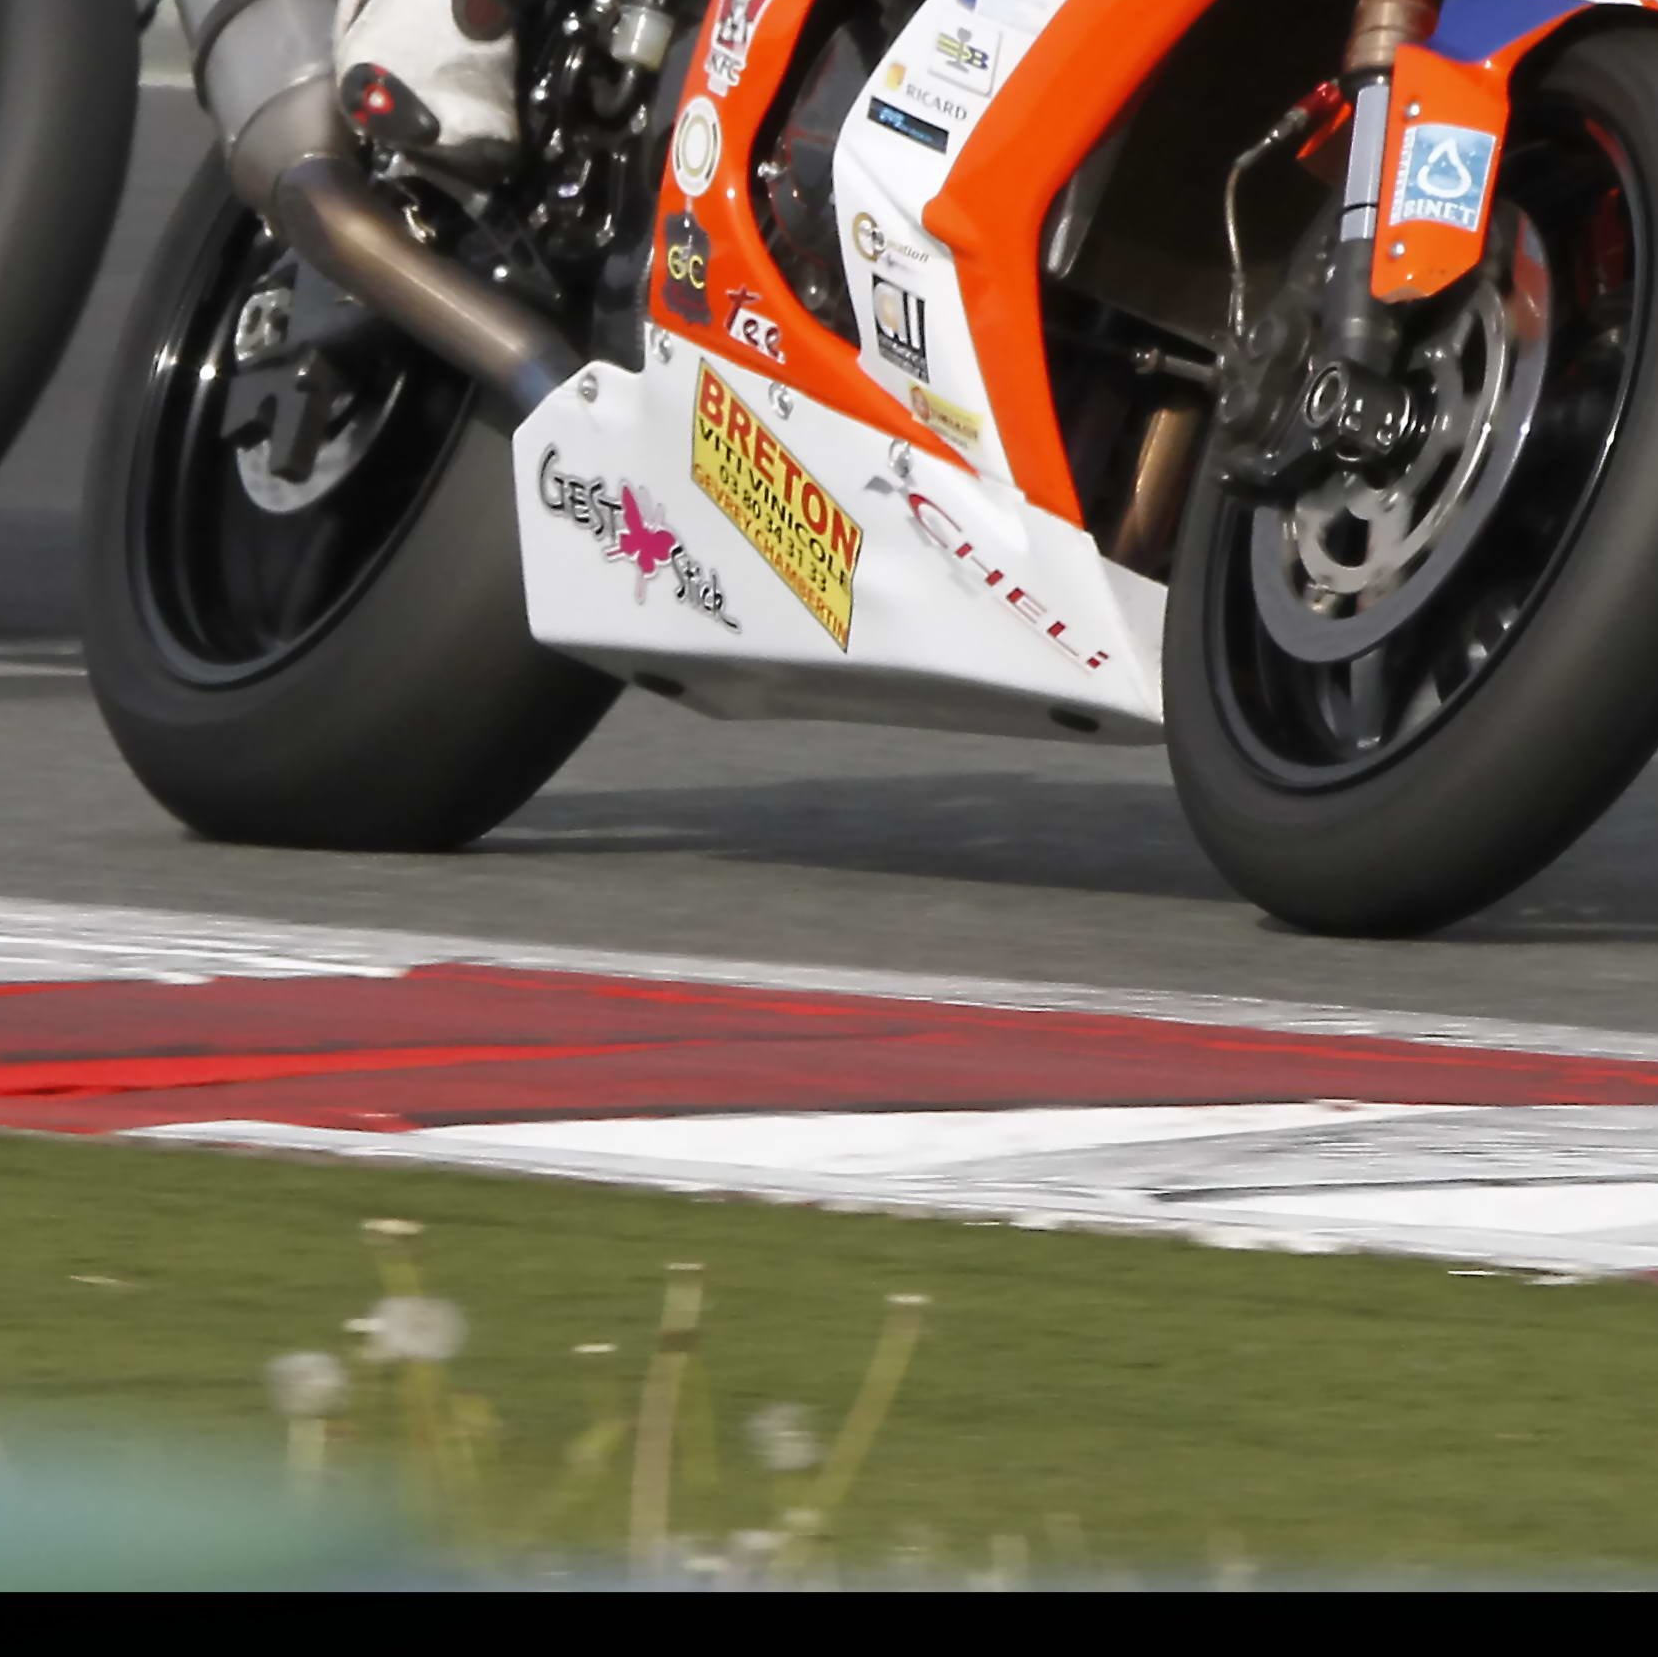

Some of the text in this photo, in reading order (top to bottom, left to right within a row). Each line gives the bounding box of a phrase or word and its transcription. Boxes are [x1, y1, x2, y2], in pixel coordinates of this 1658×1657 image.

[905, 82, 968, 122] RICARD
[1402, 198, 1476, 225] BINET
[699, 368, 859, 571] BRETON
